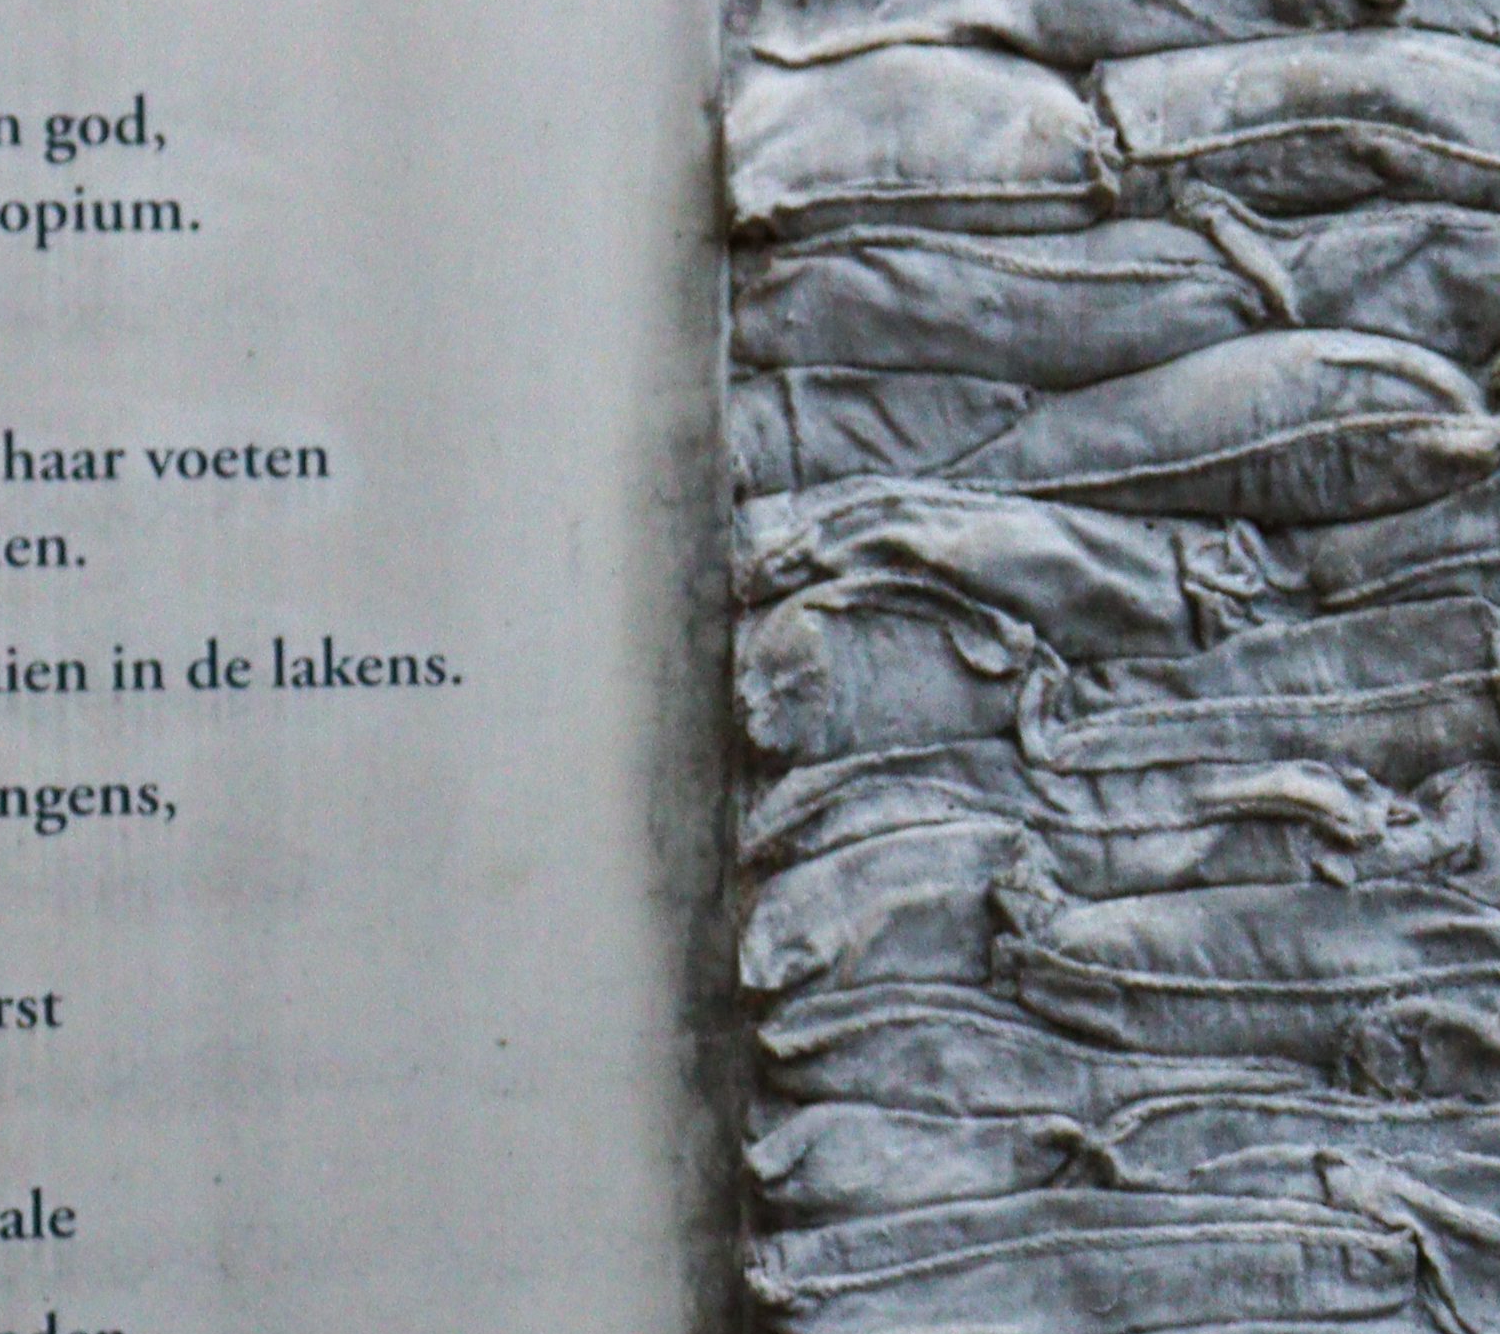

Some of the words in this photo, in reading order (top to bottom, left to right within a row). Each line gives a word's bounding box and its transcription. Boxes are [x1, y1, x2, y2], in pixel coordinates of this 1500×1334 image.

[42, 90, 169, 168] god,
[1, 426, 128, 484] haar
[143, 441, 331, 482] voeten
[110, 642, 167, 695] in
[184, 634, 254, 693] de
[270, 633, 465, 692] lakens.
